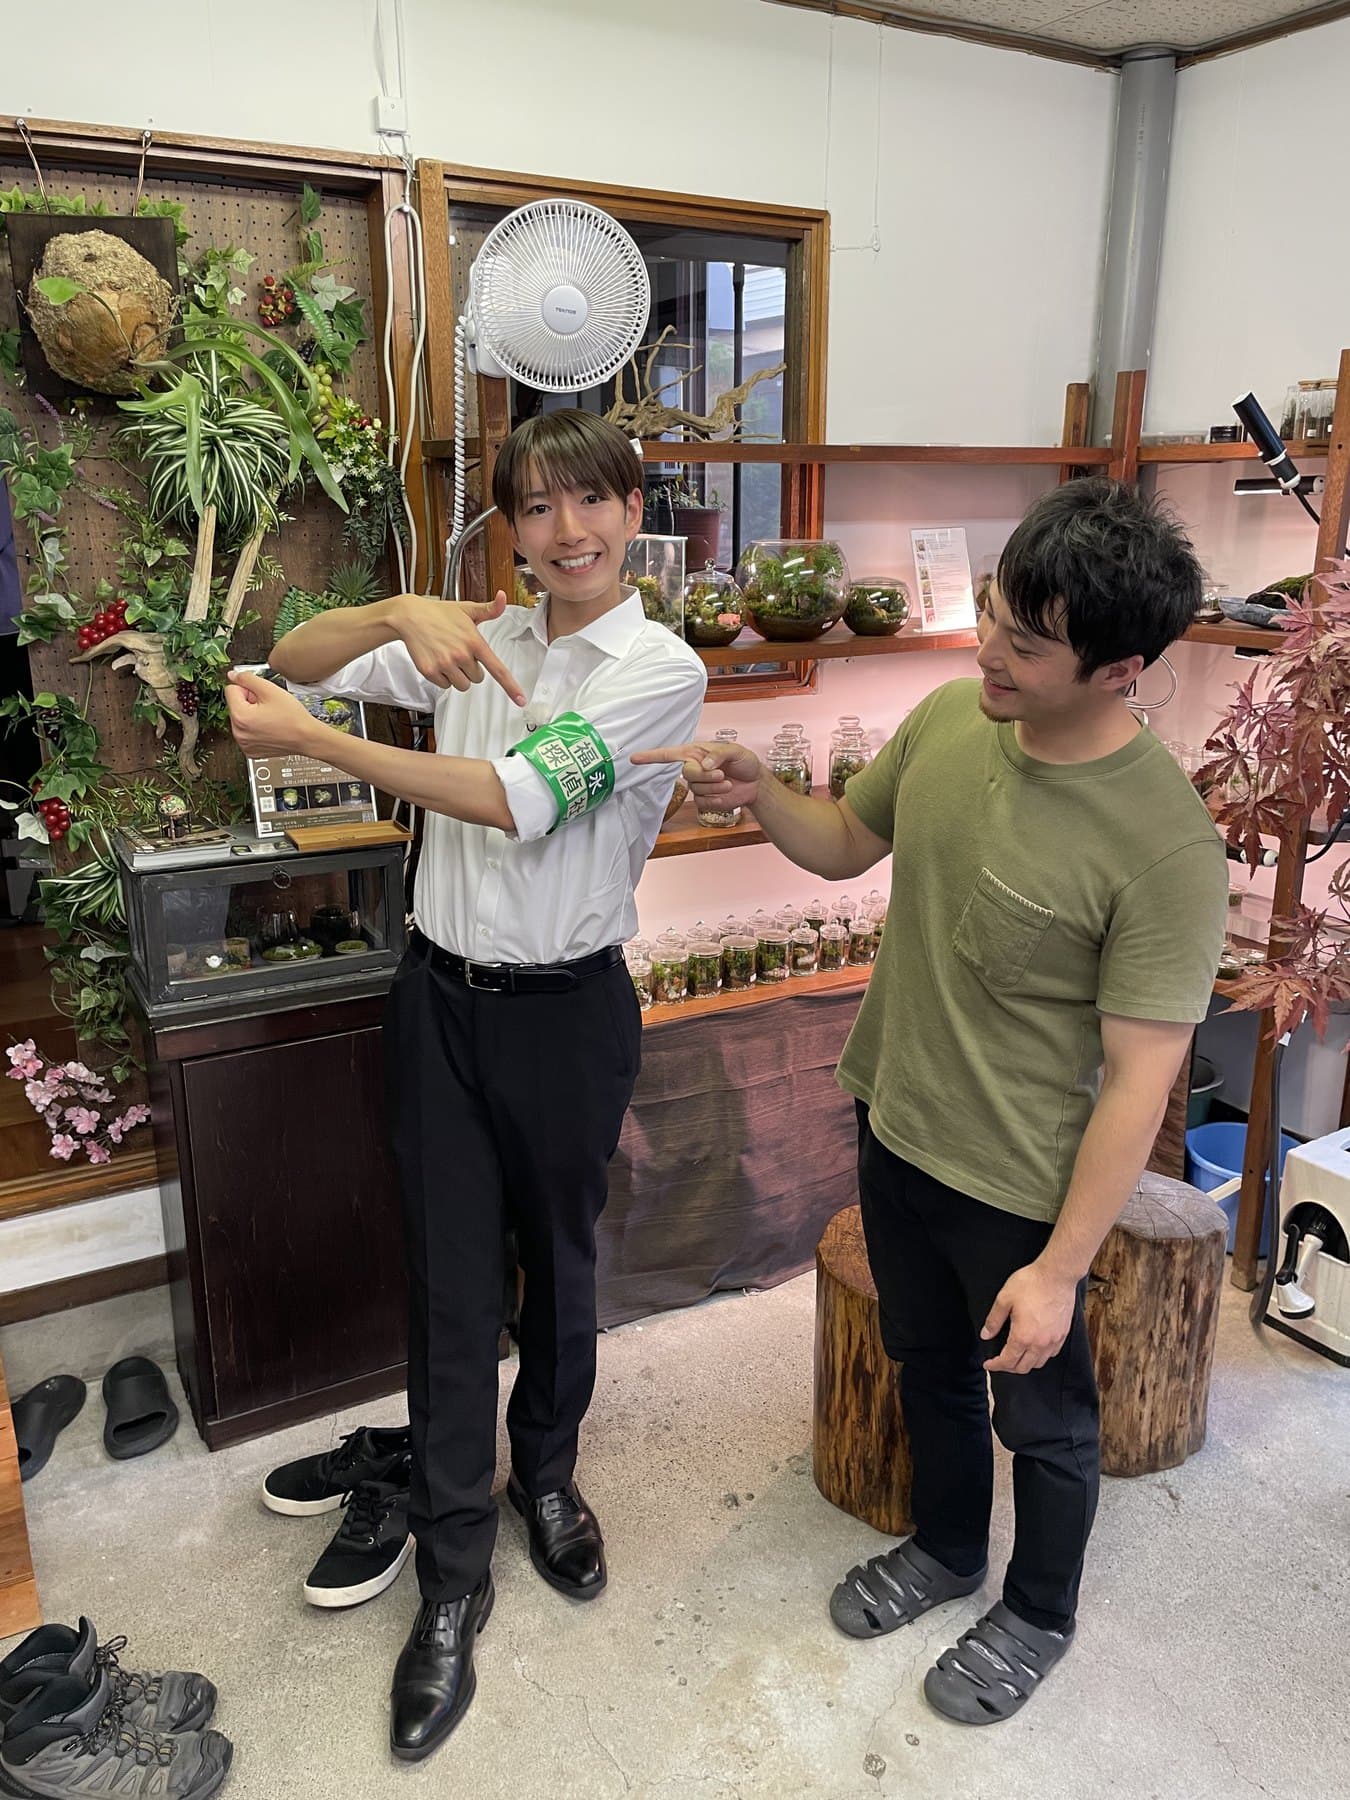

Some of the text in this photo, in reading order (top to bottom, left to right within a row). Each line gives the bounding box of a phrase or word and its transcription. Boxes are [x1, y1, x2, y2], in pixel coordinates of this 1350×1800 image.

[541, 743, 586, 817] 探偵社
[573, 741, 606, 796] 福永
